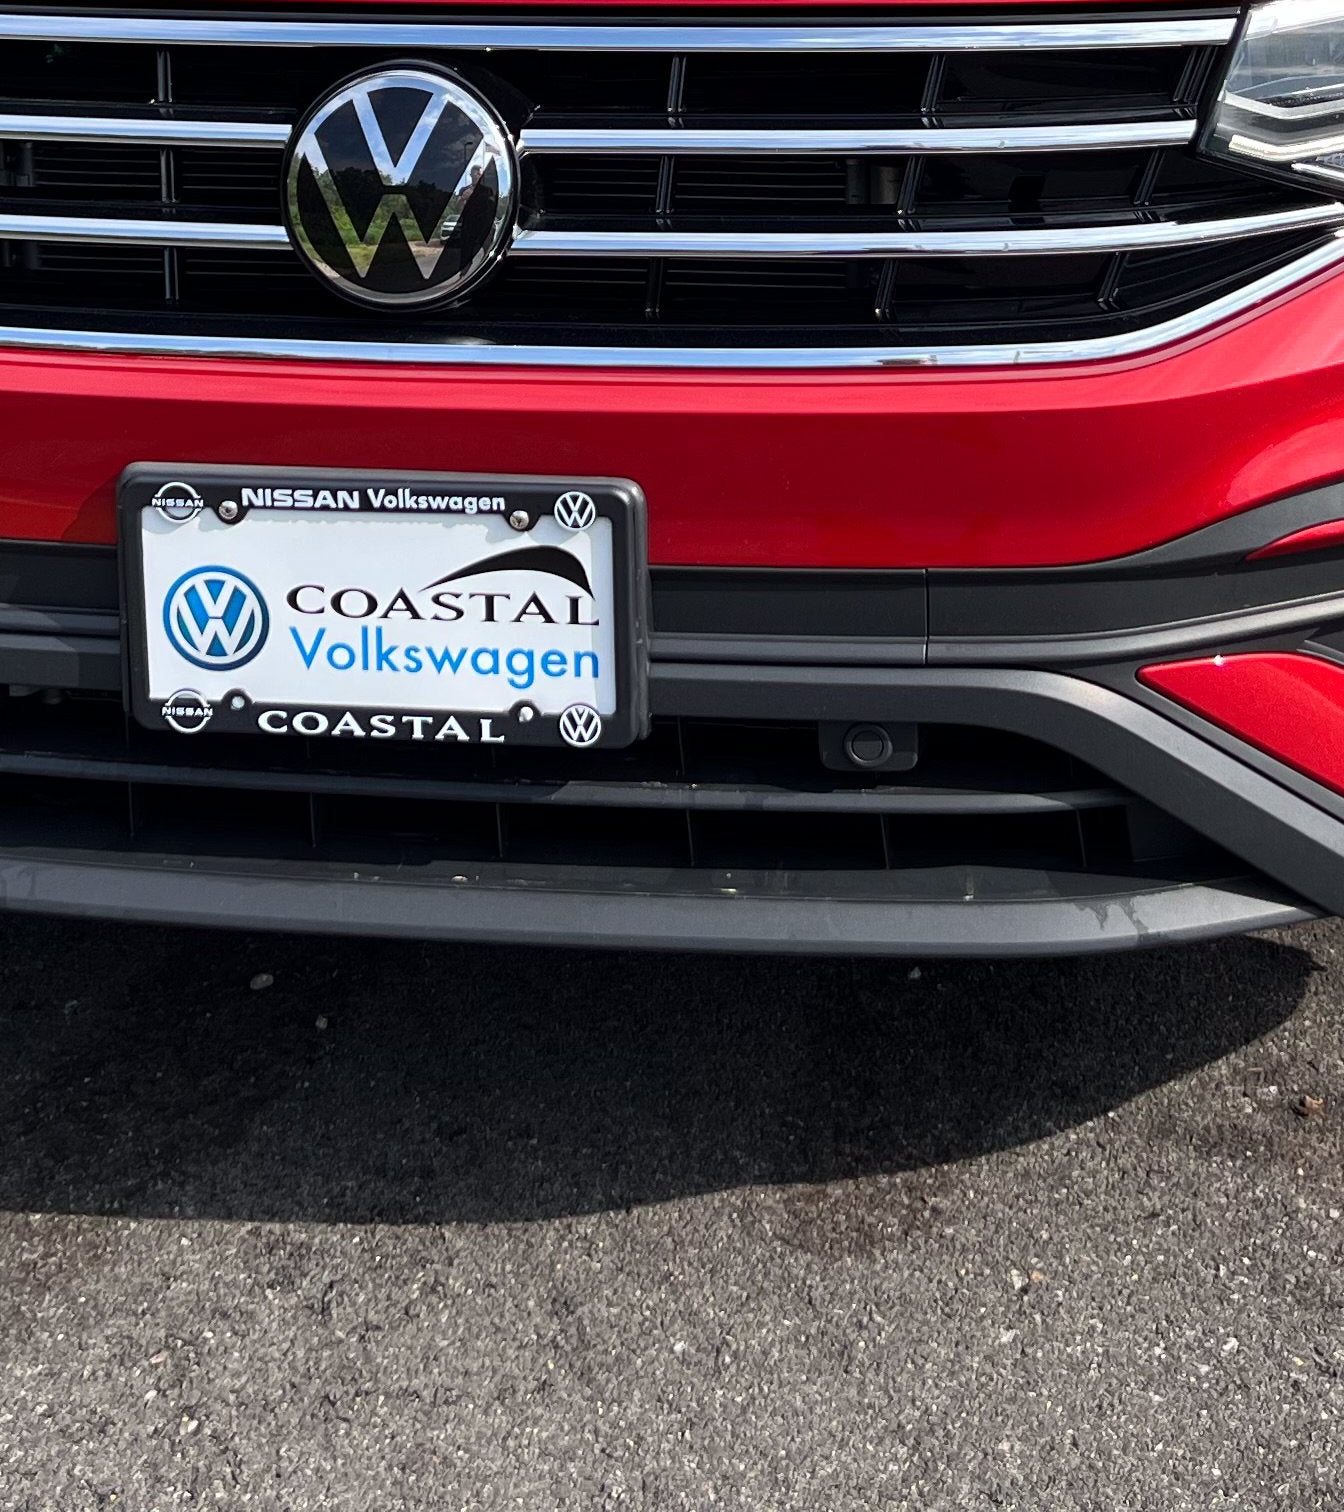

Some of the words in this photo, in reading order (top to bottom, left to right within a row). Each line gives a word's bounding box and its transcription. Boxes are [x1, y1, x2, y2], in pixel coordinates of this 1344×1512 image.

[151, 495, 204, 509] NISSAN
[241, 488, 359, 509] NISSAN
[366, 487, 506, 514] Volkswagen
[286, 584, 600, 626] COASTAL
[289, 626, 599, 689] Volkswagen
[161, 705, 214, 718] NISSAN
[257, 709, 506, 743] COASTAL
